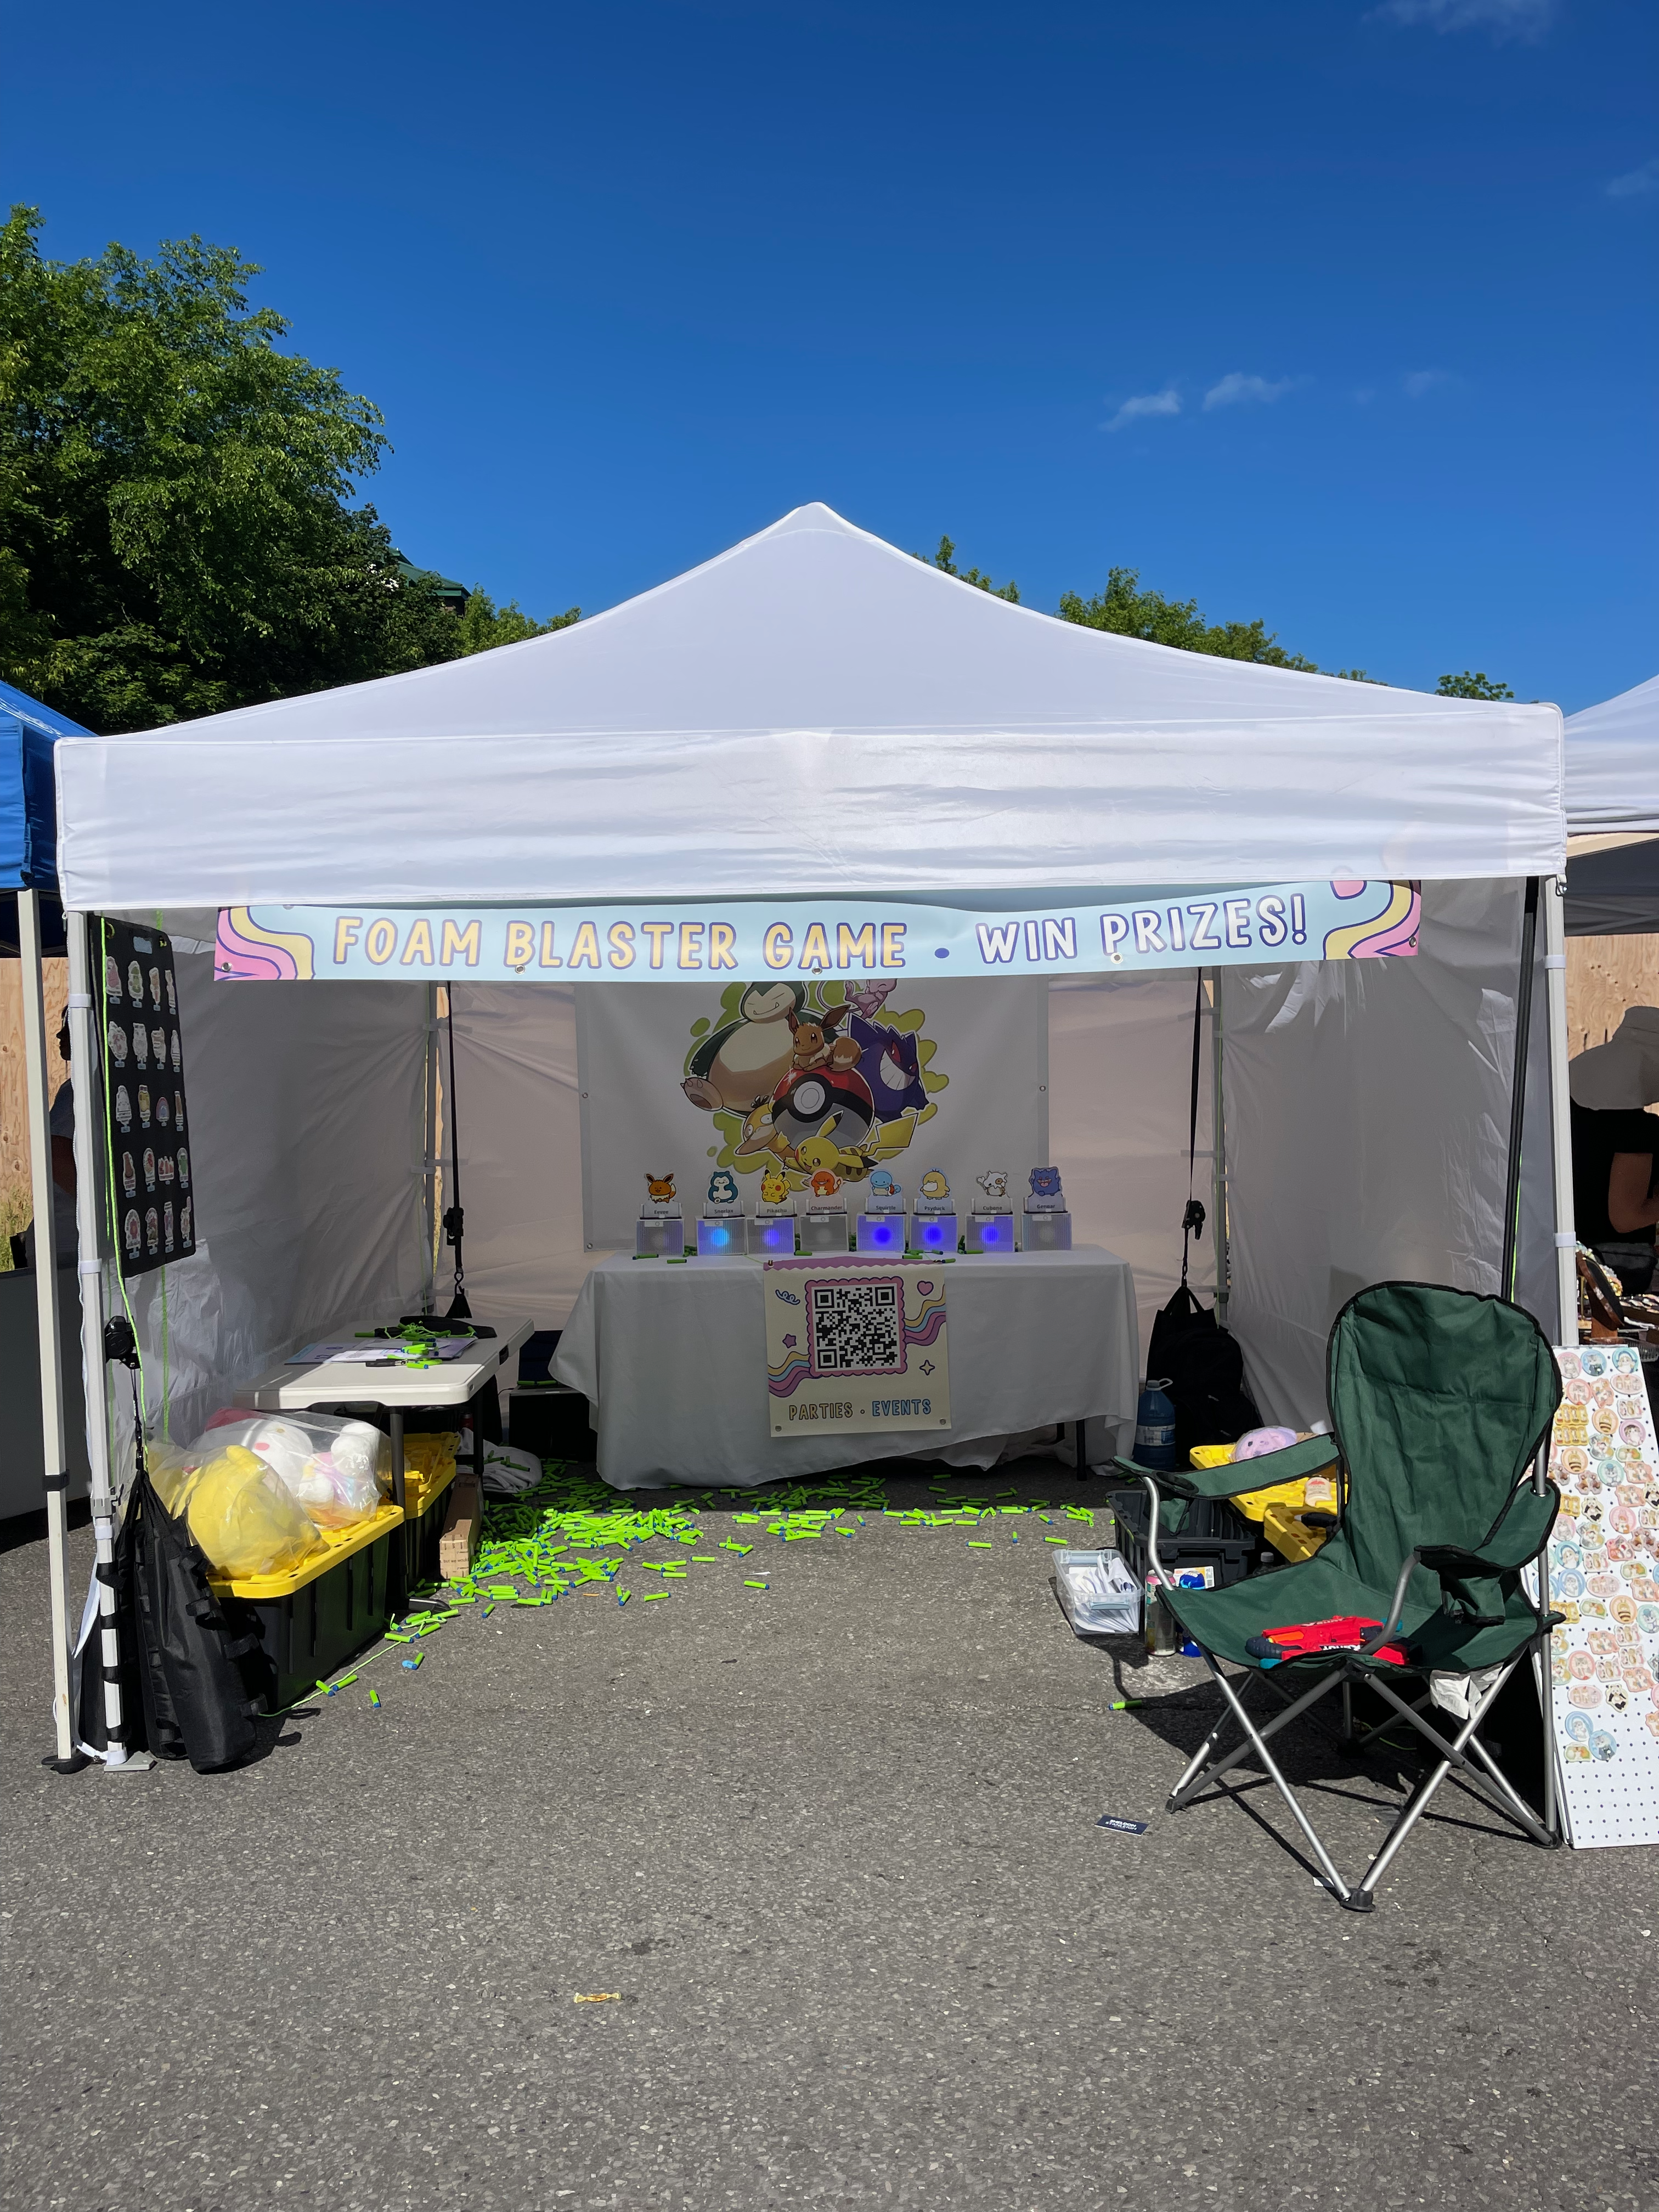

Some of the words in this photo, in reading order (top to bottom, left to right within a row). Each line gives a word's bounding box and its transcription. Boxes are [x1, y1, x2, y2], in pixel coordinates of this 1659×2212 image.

[334, 916, 482, 967] FOAM
[504, 920, 738, 969] BLASTER
[763, 921, 907, 970] GAME
[975, 917, 1077, 964] WIN
[1099, 893, 1307, 956] PRIZES!
[789, 1402, 853, 1420] PARTIES
[872, 1399, 931, 1417] EVENTS
